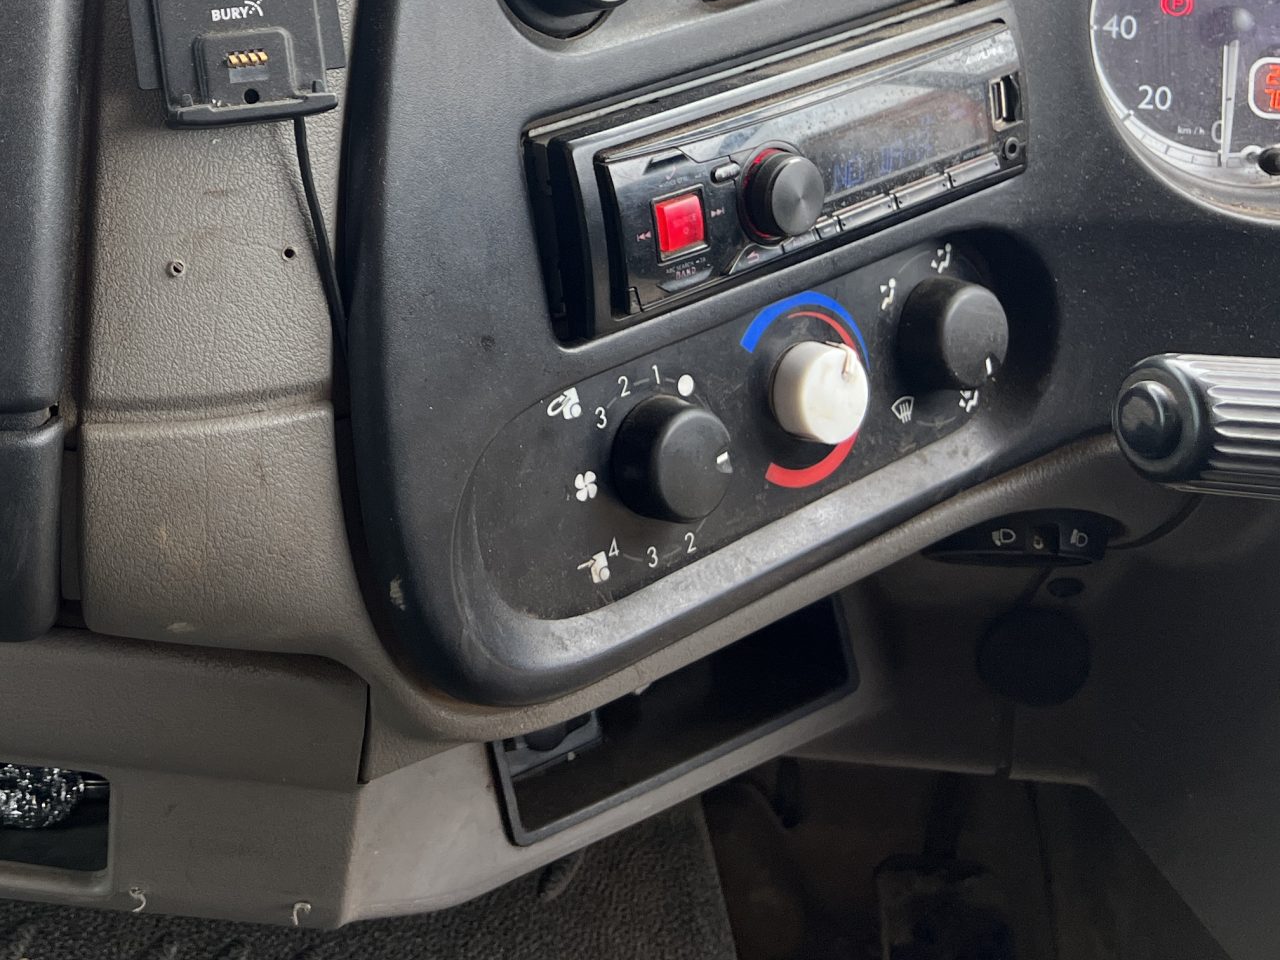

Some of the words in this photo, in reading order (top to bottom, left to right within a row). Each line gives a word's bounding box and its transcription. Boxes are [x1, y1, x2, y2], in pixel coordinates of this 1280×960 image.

[211, 6, 250, 22] BURY
[1102, 15, 1137, 40] 40
[1138, 85, 1172, 110] 20
[651, 364, 661, 385] 1
[618, 375, 631, 398] 2
[594, 406, 608, 429] 3
[608, 535, 620, 557] 4
[684, 531, 697, 554] 2
[646, 545, 659, 568] 3
